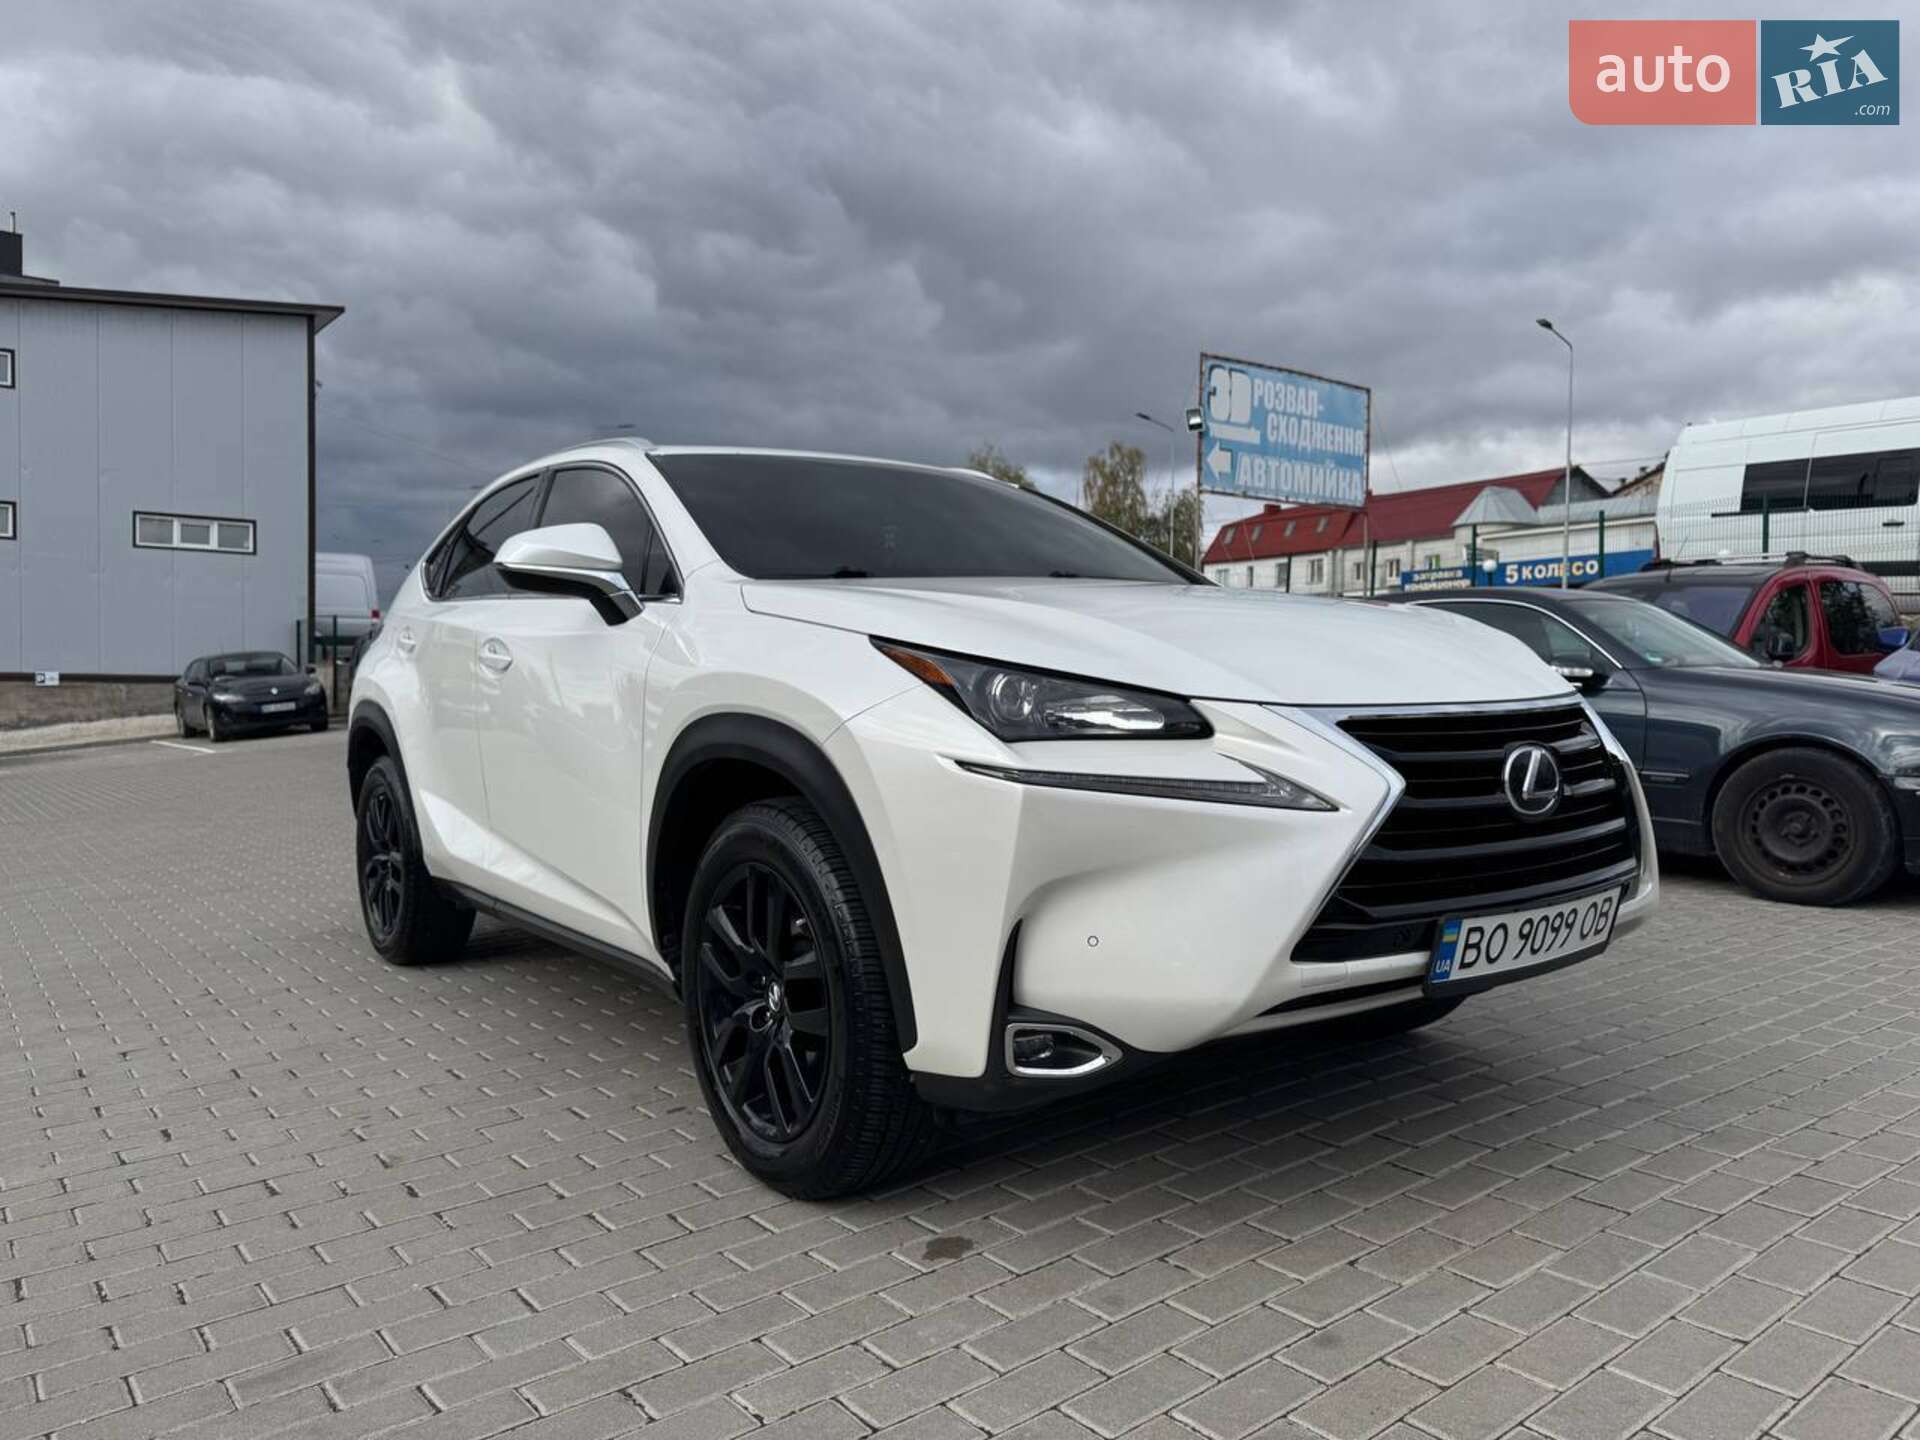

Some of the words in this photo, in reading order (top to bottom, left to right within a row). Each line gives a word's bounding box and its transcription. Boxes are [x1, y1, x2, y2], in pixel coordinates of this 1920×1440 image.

[1253, 378, 1325, 419] РОЗВАЛ-
[1266, 413, 1365, 457] СХОДЖЕННЯ
[1236, 451, 1362, 500] АВТОМИЙКА
[1505, 563, 1519, 584] 5
[1458, 922, 1509, 970] BO
[1512, 908, 1578, 960] 9099
[1580, 896, 1614, 940] OB
[1435, 959, 1450, 973] UA
